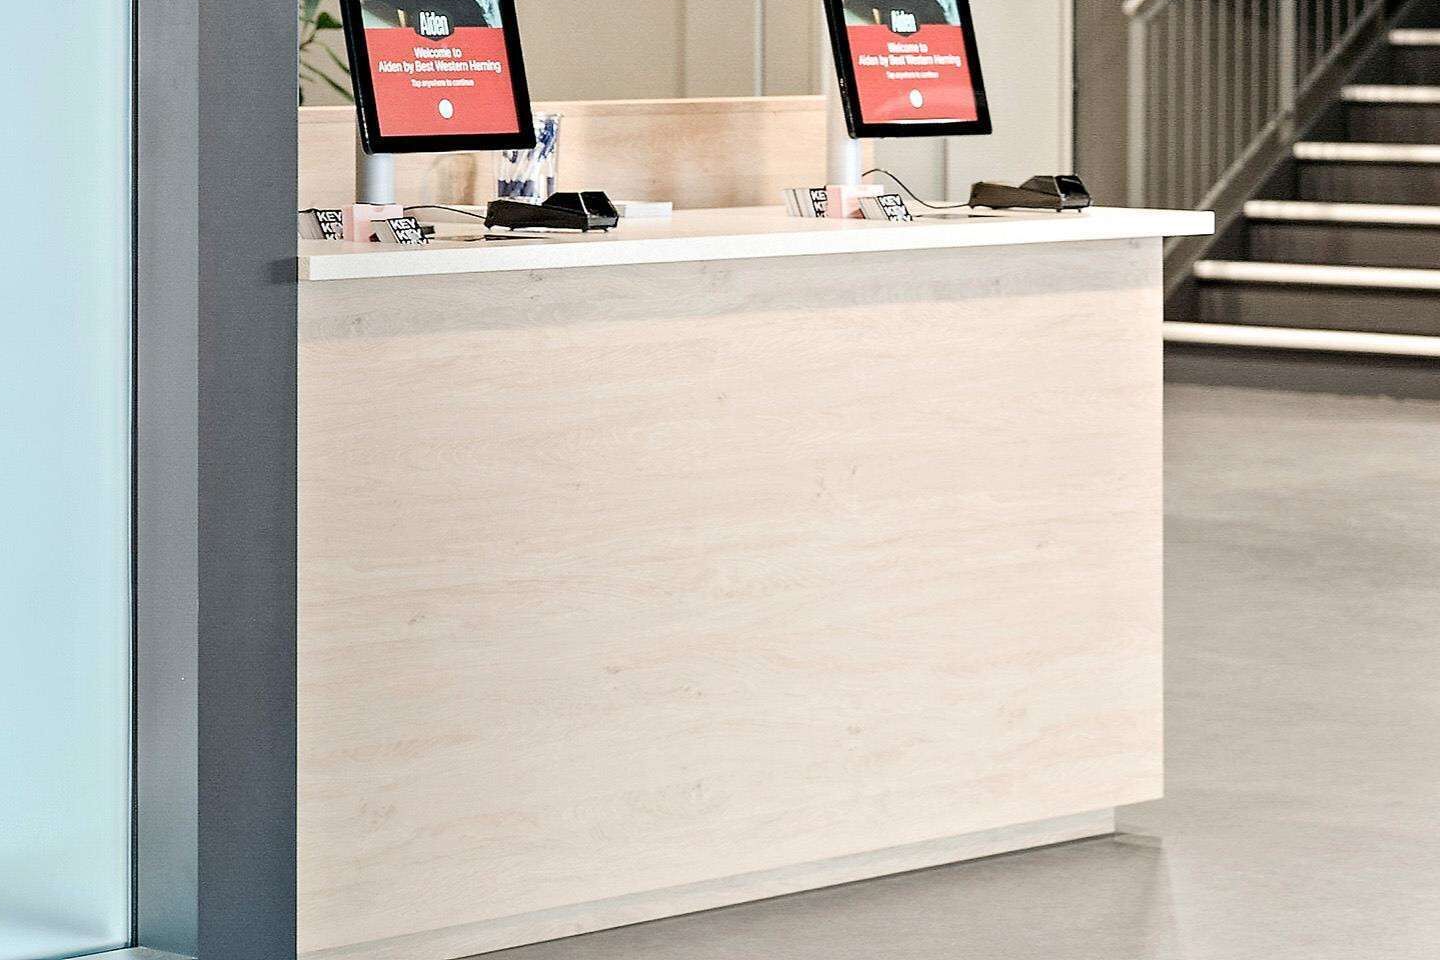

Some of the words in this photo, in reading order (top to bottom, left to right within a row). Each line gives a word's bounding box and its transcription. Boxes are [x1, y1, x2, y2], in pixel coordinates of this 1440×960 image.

[419, 11, 450, 36] Aiden
[413, 47, 451, 59] Welcome
[452, 47, 462, 59] to
[378, 61, 403, 73] Aiden
[415, 60, 434, 73] Best
[435, 60, 470, 72] Western
[389, 218, 417, 230] KEY
